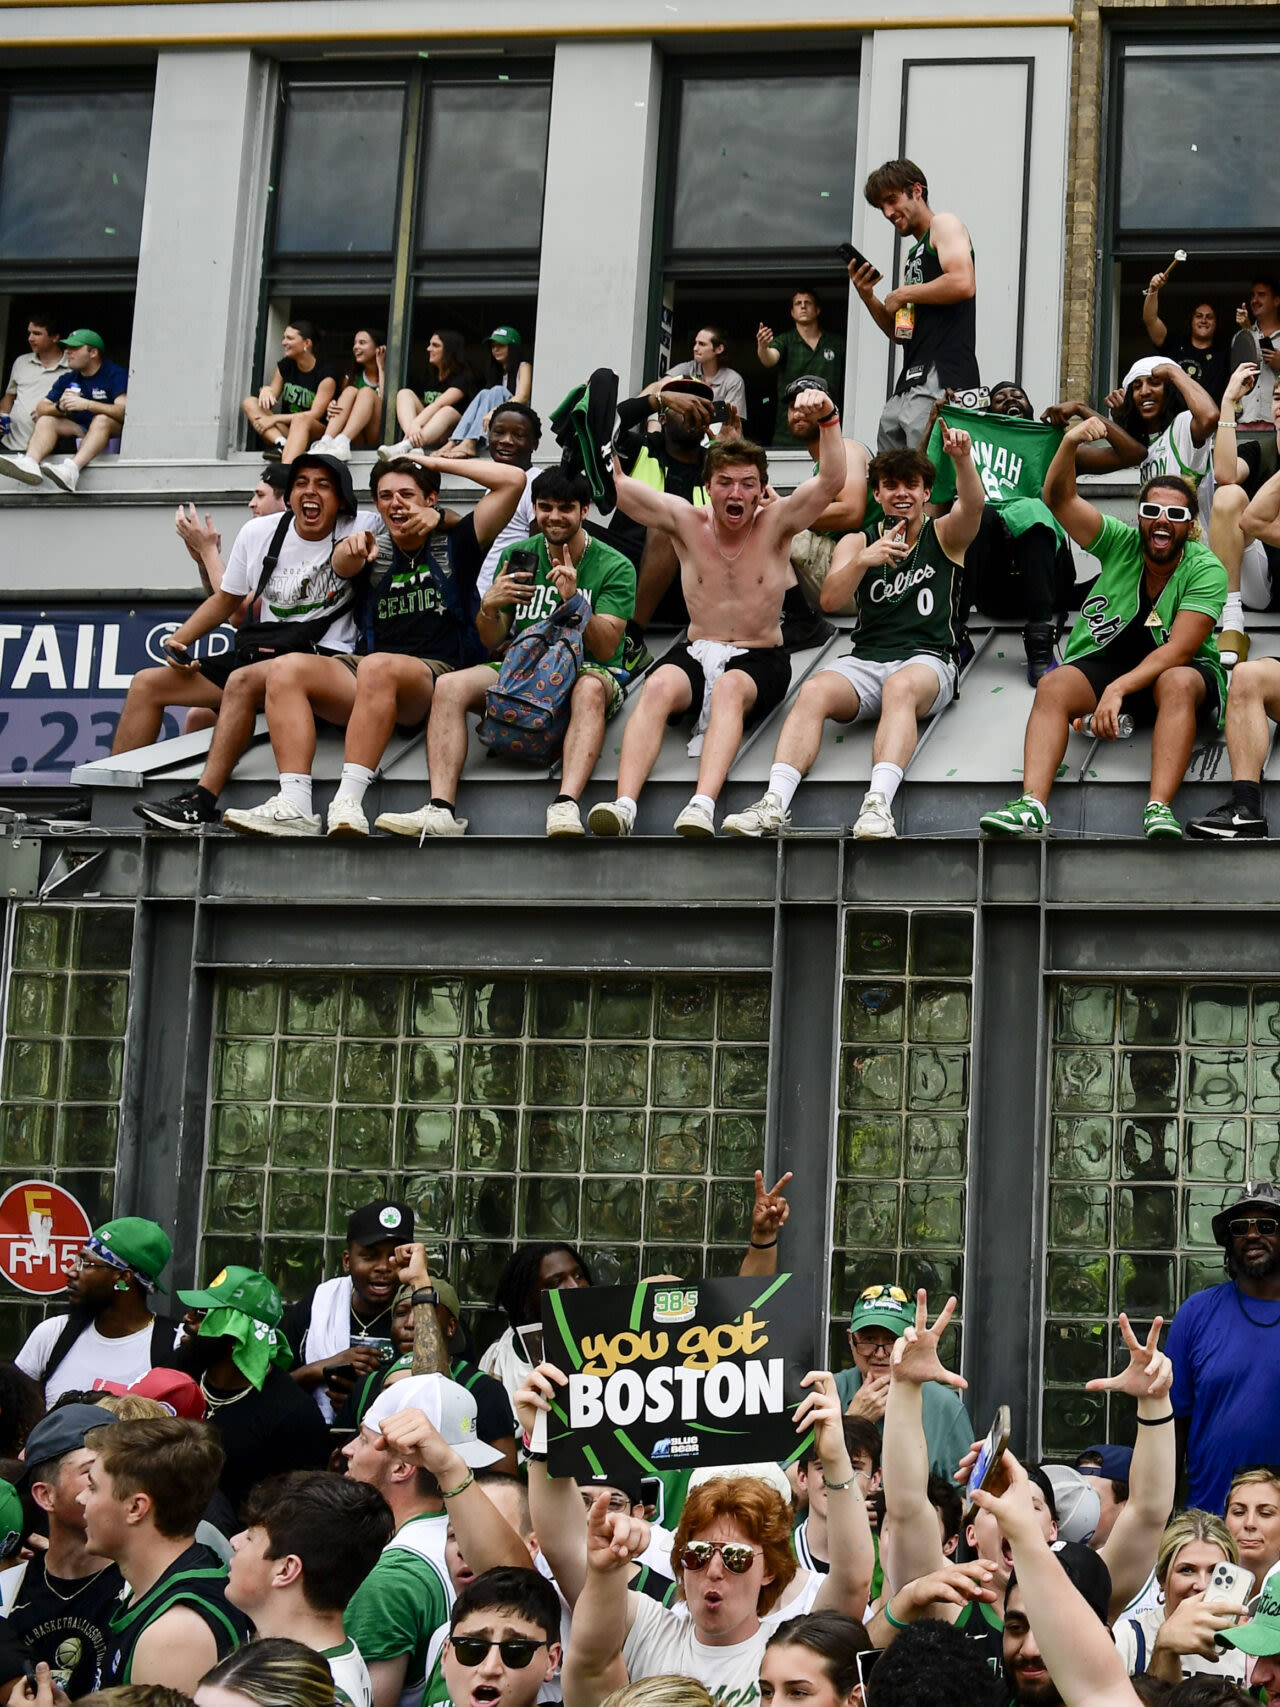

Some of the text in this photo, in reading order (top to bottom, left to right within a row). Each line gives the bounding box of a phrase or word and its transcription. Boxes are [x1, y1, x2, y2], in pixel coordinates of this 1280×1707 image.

[970, 440, 1023, 485] NNAH
[870, 564, 936, 603] Celtics
[916, 587, 934, 616] 0
[653, 1290, 699, 1312] 98.5
[580, 1312, 771, 1377] you got
[568, 1358, 785, 1430] BOSTON
